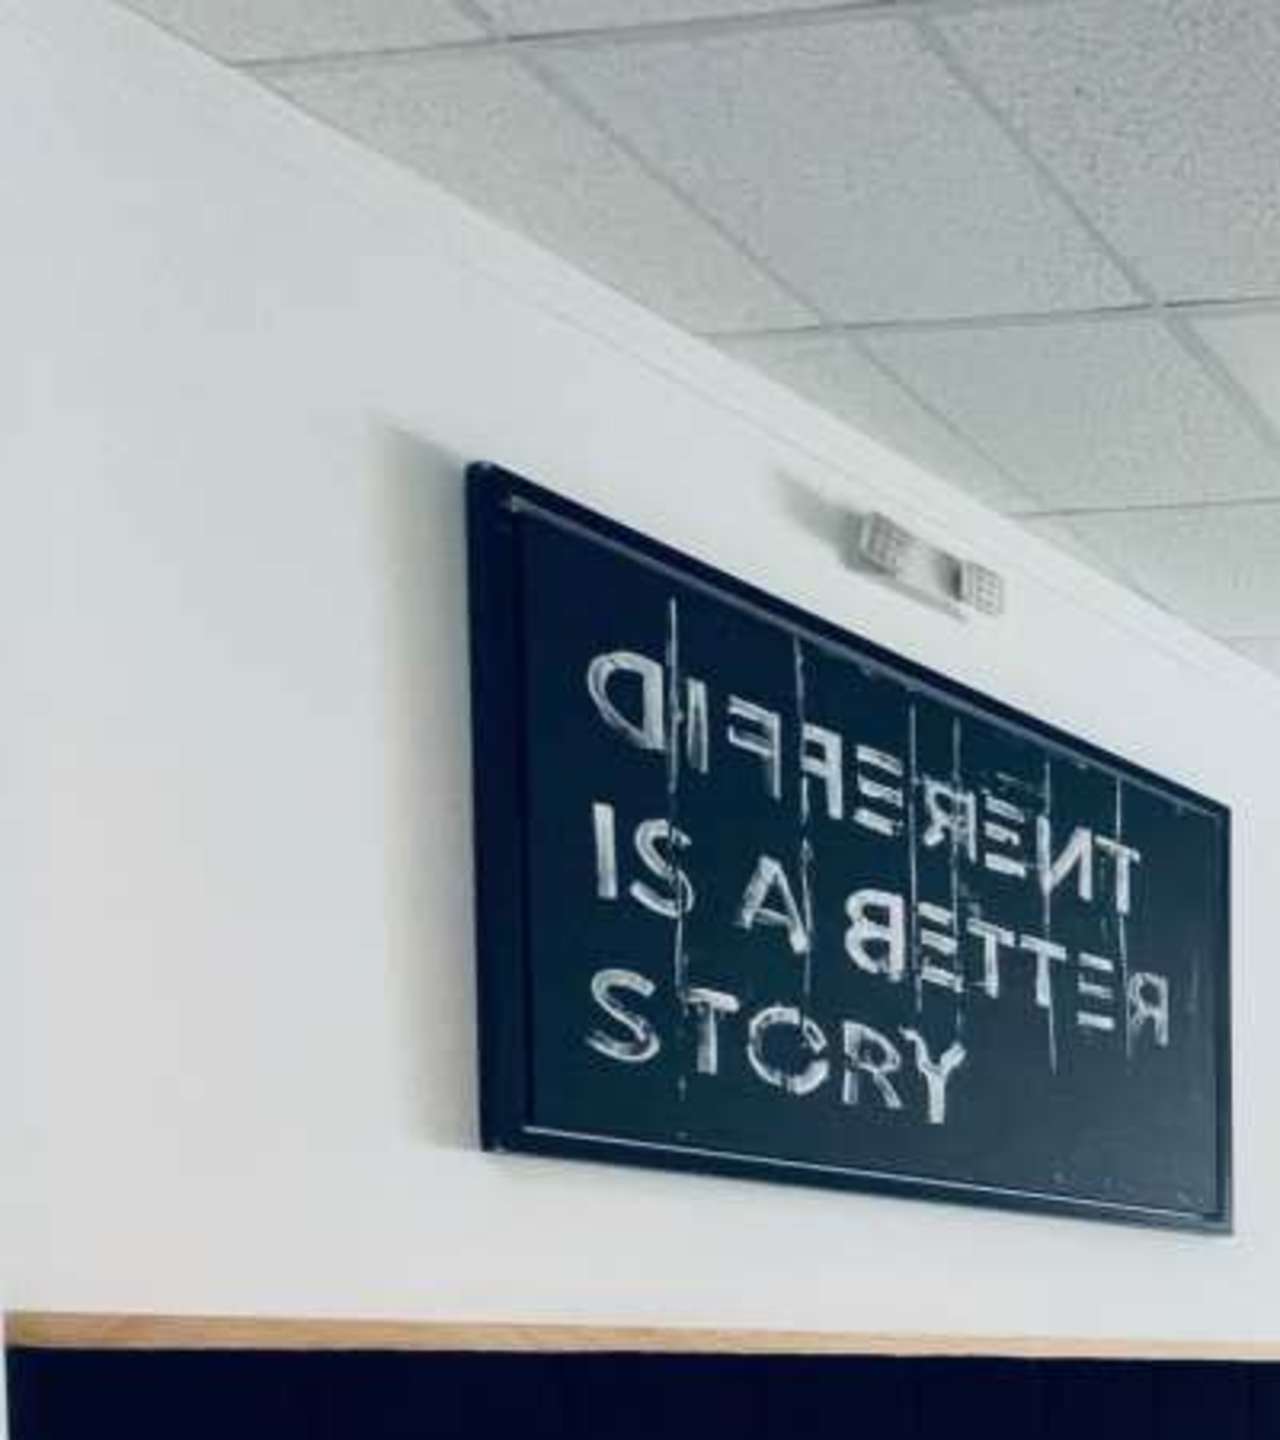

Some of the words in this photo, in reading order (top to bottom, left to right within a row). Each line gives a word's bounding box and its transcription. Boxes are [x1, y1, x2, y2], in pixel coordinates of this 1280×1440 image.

[587, 651, 1141, 914] DIFFERENT
[592, 803, 693, 917] IS
[737, 856, 810, 954] A
[845, 890, 1169, 1046] BETTER
[587, 970, 966, 1124] STORY
